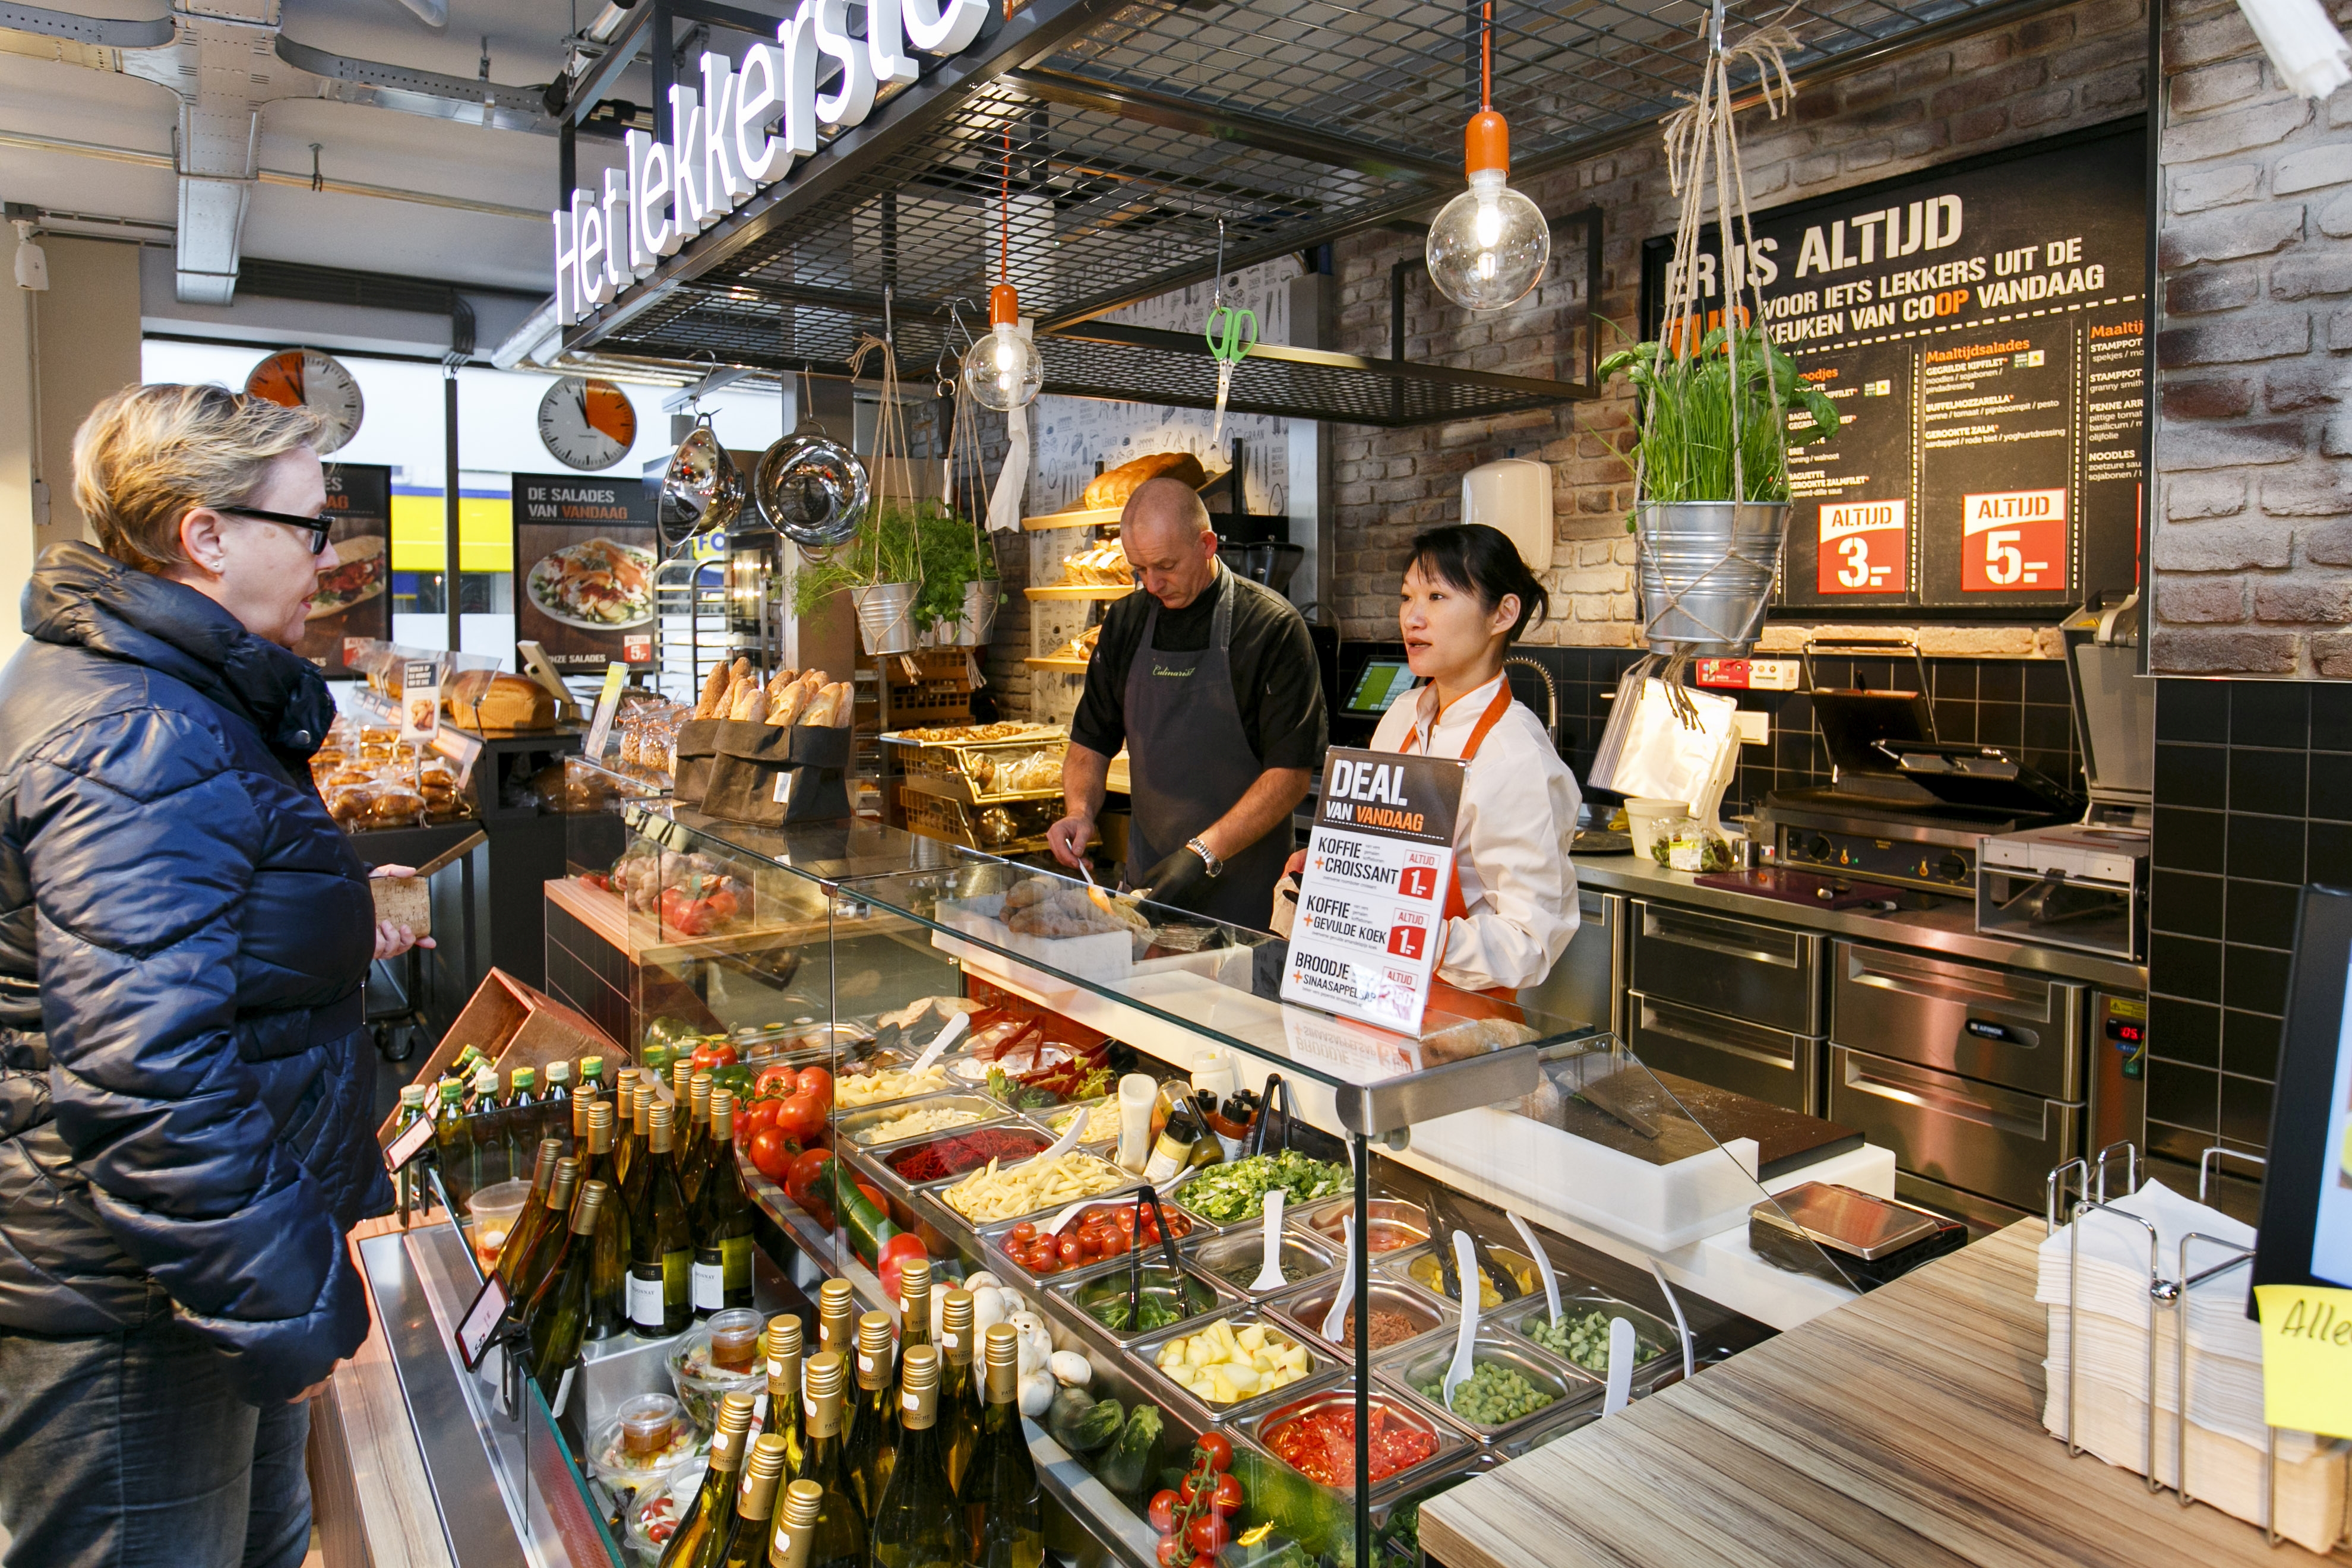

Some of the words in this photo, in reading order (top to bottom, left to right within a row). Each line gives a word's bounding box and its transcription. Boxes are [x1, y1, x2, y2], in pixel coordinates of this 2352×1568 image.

[552, 168, 635, 325] Het
[625, 0, 989, 268] lekkers
[1665, 254, 1715, 306] ER
[1733, 238, 1778, 292] IS
[1795, 194, 1962, 278] ALTIJD
[1762, 291, 1817, 320] VOOR
[1825, 279, 1872, 309] IETS
[1880, 257, 1986, 298] LEKKERS
[1995, 246, 2038, 276] UIT
[2047, 237, 2082, 267] DE
[1850, 302, 1895, 331] VAN
[1902, 289, 1970, 322] COOP
[1977, 264, 2104, 309] VANDAAG
[1926, 339, 2030, 363] Maaltijdsalades
[2091, 338, 2143, 352] STAMPPOT
[2092, 352, 2123, 363] spekjes
[1926, 363, 1966, 375] GEGRILDE
[2090, 368, 2142, 382] STAMPPOT
[1926, 375, 1954, 385] noodles
[1959, 369, 1998, 381] sojabonen
[1926, 382, 1975, 394] pindadressing
[2090, 383, 2119, 394] granny
[2120, 379, 2144, 389] smith
[1925, 412, 1948, 422] penne
[1953, 408, 1979, 418] tomaat
[1985, 402, 2031, 415] pijnboompit
[2037, 400, 2059, 410] pesto
[2089, 400, 2122, 412] PENNE
[2089, 411, 2116, 423] pittige
[1925, 426, 1970, 440] GEROOKTE
[2089, 420, 2129, 432] basilicum
[1244, 429, 1264, 442] GRAAN
[1925, 438, 1959, 448] aardappel
[1965, 435, 1982, 445] rode
[1983, 434, 1997, 442] biet
[2003, 428, 2066, 442] yoghurtdressing
[2089, 432, 2119, 442] olijfolie
[1788, 447, 1804, 456] BRIE
[1814, 453, 1839, 461] walnoot
[2089, 450, 2135, 461] NOODLES
[2088, 461, 2125, 471] zoetzure
[1788, 470, 1825, 480] BAGUETTE
[2088, 472, 2132, 481] sojabonen
[1789, 479, 1825, 490] GEROOKTE
[1826, 476, 1865, 486] ZALMFILET
[528, 487, 546, 501] DE
[552, 489, 615, 503] SALADES
[528, 505, 557, 517] VAN
[562, 506, 627, 520] VANDAAG
[1978, 496, 2050, 519] ALTIJD
[1832, 507, 1892, 527] ALTIJD
[569, 655, 605, 663] SALADES
[1329, 760, 1408, 806] DEAL
[1326, 801, 1353, 821] VAN
[1357, 805, 1424, 832] VANDAAG
[1318, 837, 1362, 859] KOFFIE
[1409, 853, 1434, 865] ALTIJD
[1307, 895, 1351, 919] KOFFIE
[1359, 927, 1387, 944] KOEK
[1398, 912, 1424, 925] ALTIJD
[1295, 951, 1350, 980] BROODJE
[1387, 970, 1412, 985] ALTIJD
